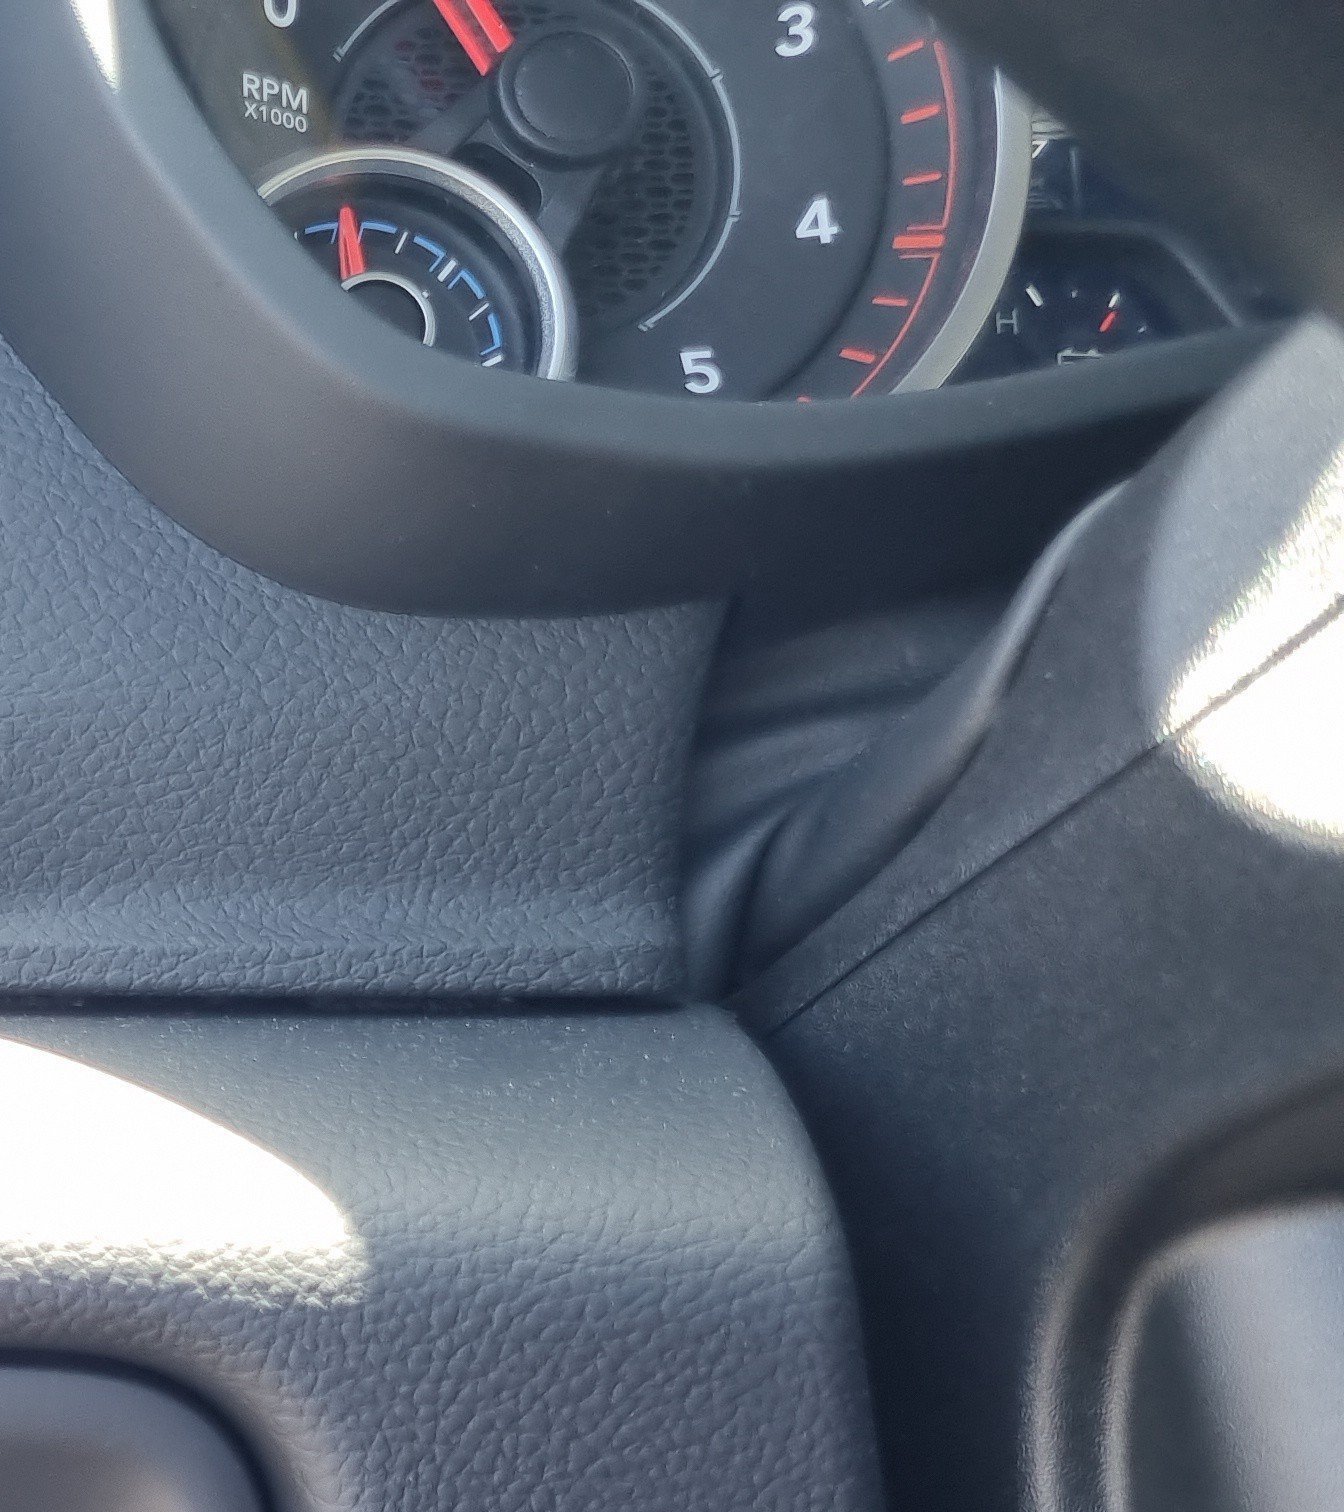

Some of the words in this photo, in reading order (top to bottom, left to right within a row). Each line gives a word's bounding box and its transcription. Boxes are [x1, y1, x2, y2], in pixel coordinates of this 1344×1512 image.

[775, 5, 814, 57] 3
[241, 73, 309, 115] RPM
[243, 101, 308, 134] X1000
[795, 197, 841, 245] 4
[679, 350, 721, 395] 5
